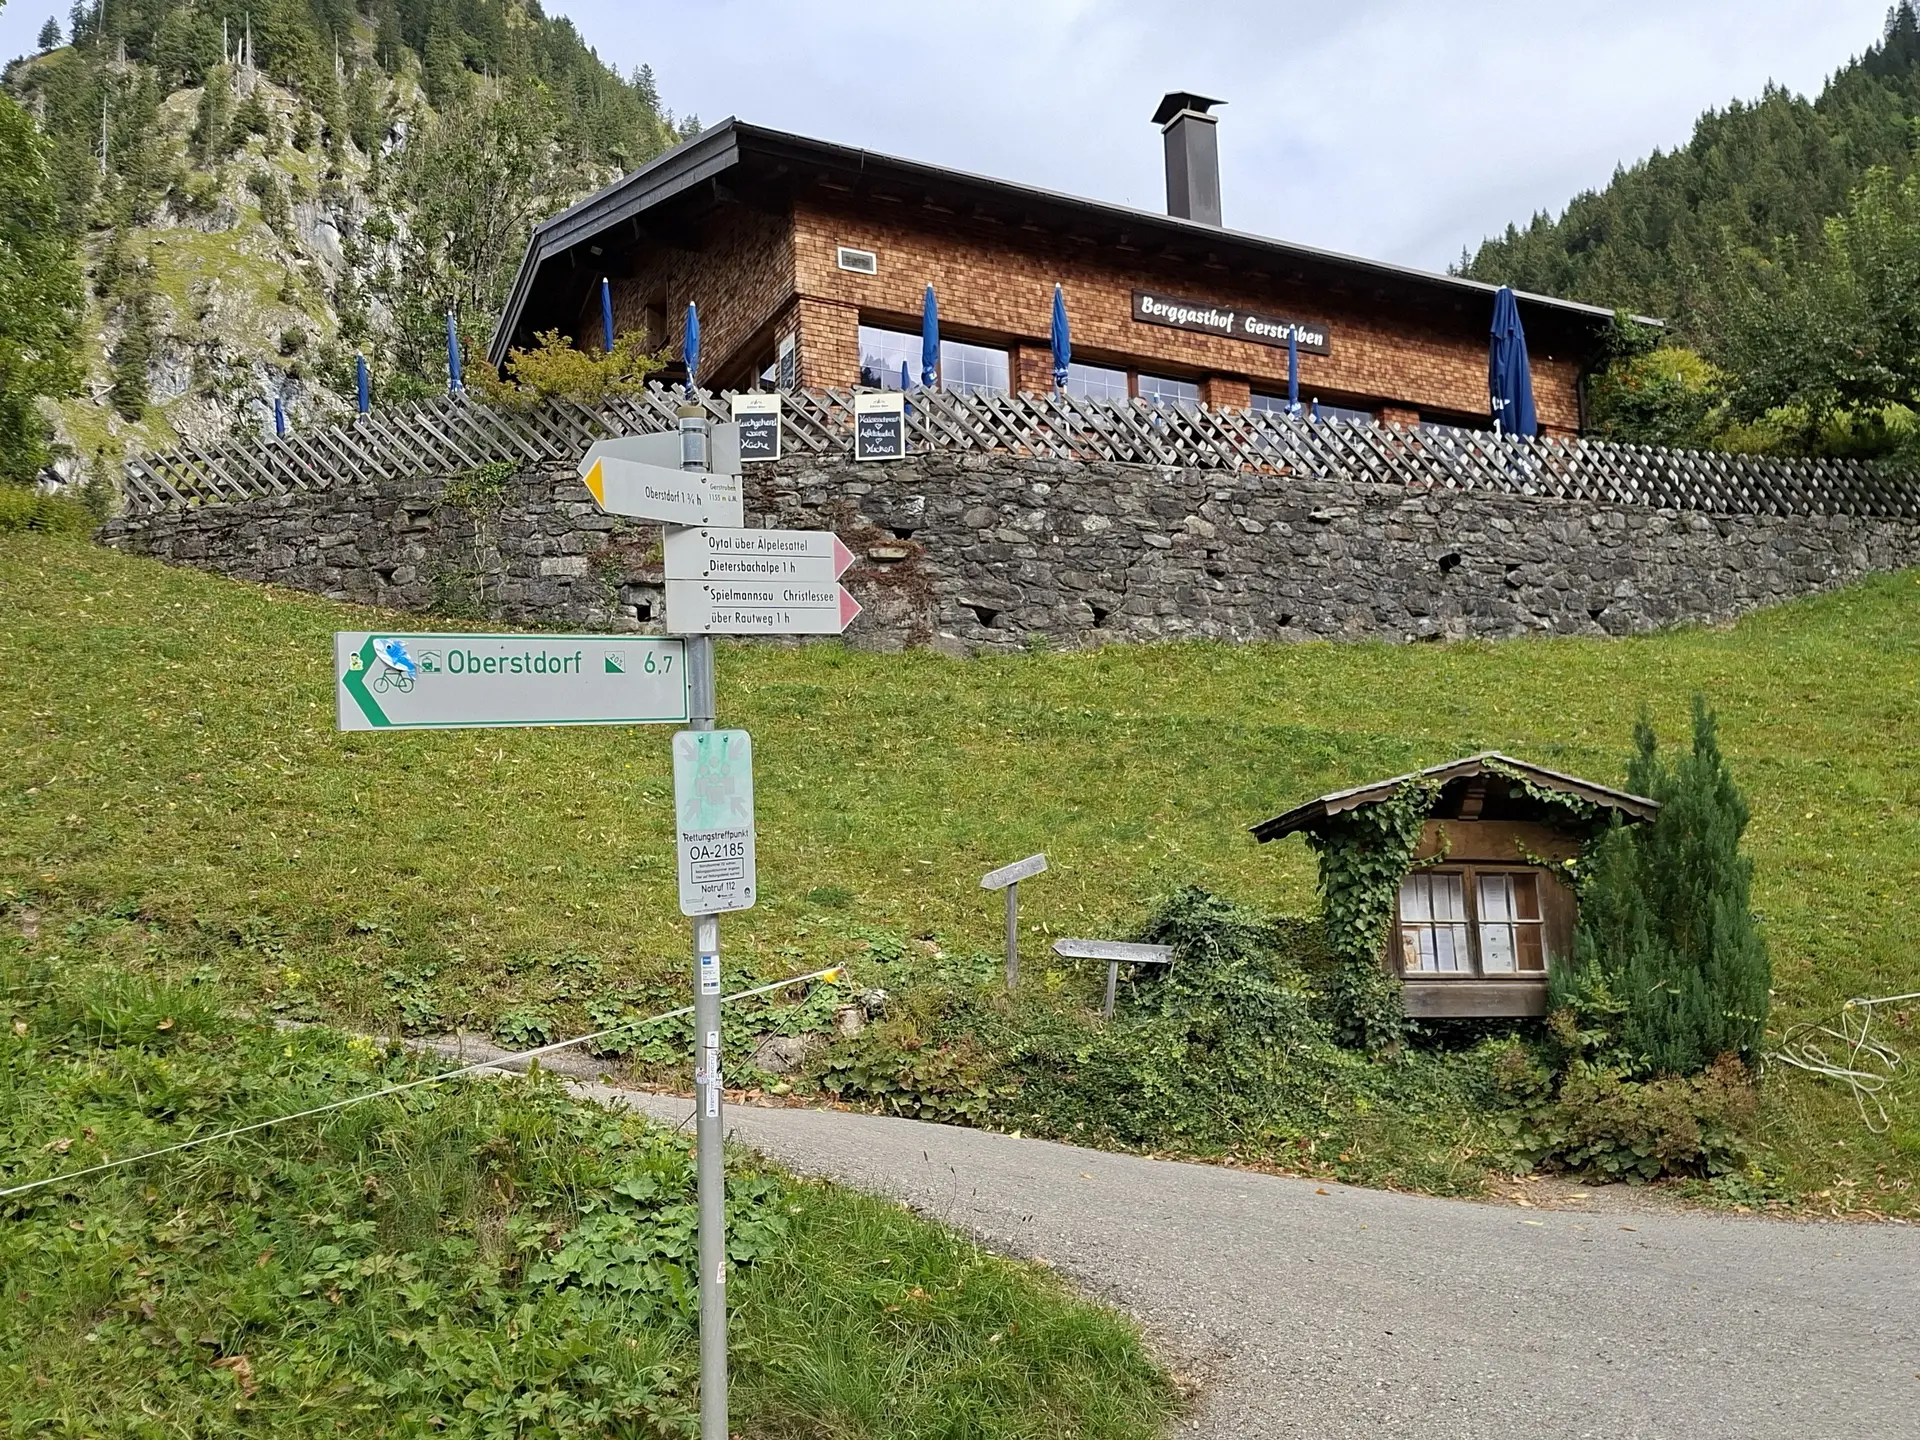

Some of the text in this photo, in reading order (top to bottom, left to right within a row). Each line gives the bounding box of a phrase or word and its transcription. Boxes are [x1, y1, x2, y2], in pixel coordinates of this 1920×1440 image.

[1141, 296, 1324, 346] Berggasthof Gerstrben
[645, 486, 680, 503] Oberstdorf
[681, 492, 686, 503] 1
[696, 494, 702, 506] h
[709, 494, 721, 502] 1155
[708, 535, 808, 552] Oytal über Älpelesattel
[709, 560, 780, 575] Dietersbachalpe
[790, 562, 796, 573] h
[710, 588, 834, 603] Spielmannsau Christlessee
[711, 611, 732, 624] über
[735, 612, 773, 626] Rautweg
[784, 612, 790, 624] h
[447, 649, 583, 675] Oberstdorf
[644, 651, 673, 675] 6,7
[682, 829, 749, 843] Rettungstreffpunkt
[689, 842, 745, 860] OA-2185
[701, 881, 736, 893] Notruf 112
